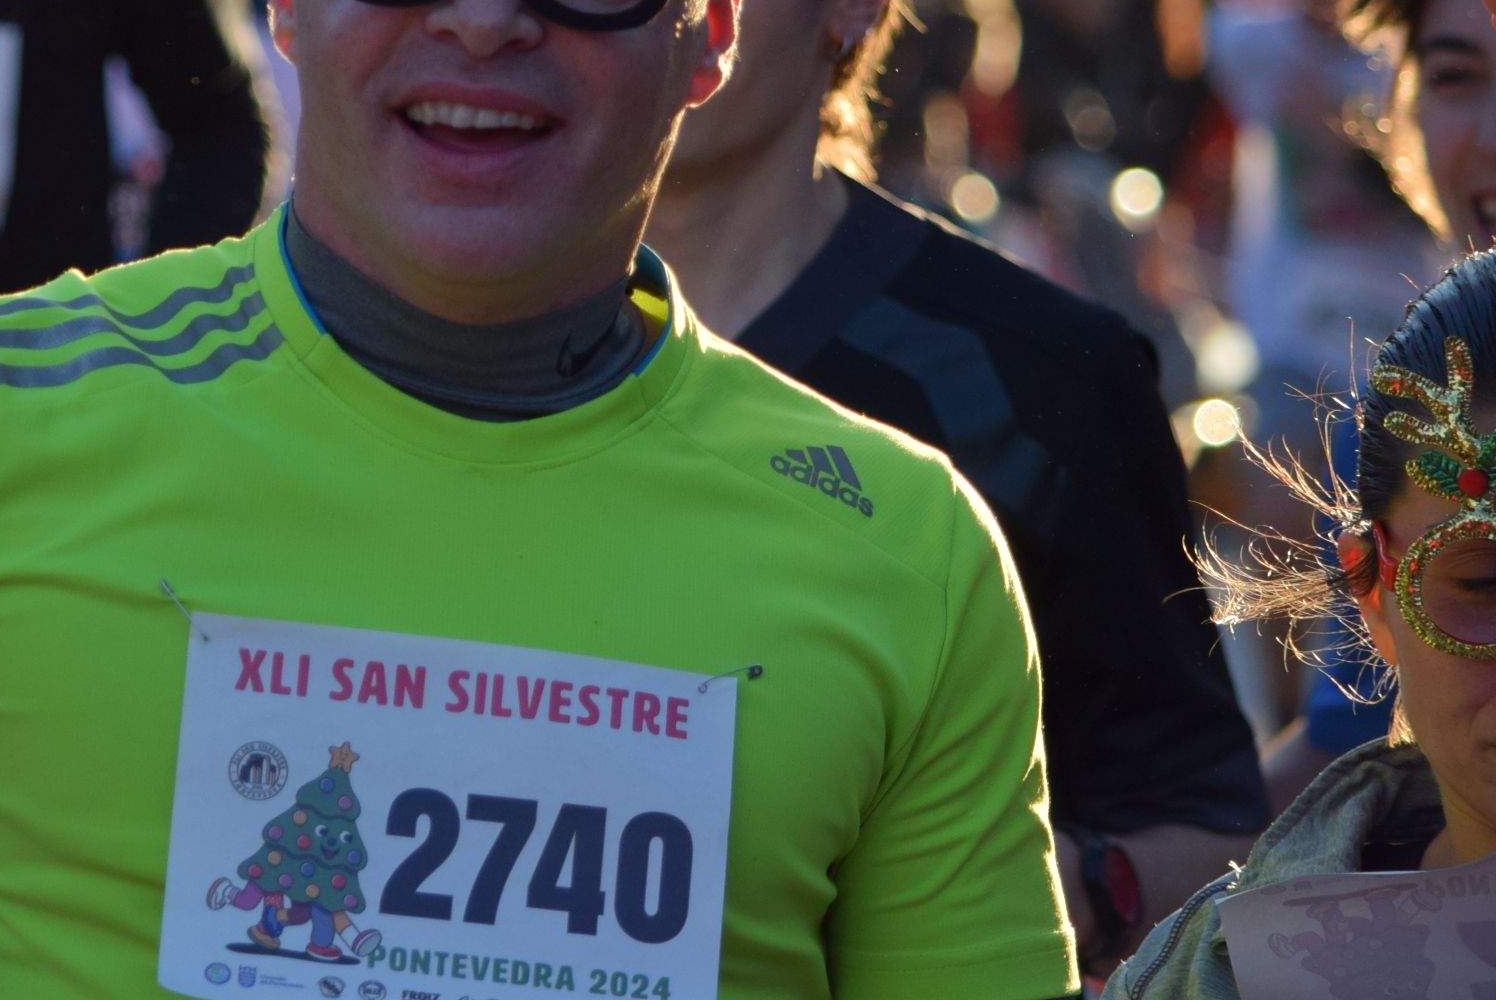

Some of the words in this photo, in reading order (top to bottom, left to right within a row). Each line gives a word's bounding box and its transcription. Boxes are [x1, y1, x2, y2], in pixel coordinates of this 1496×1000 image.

[769, 455, 874, 518] adidas
[234, 647, 310, 698] XLI
[328, 657, 427, 709] SAN
[444, 669, 690, 740] SILVESTRE
[378, 786, 694, 946] 2740
[366, 945, 575, 992] PONTEVEDRA
[589, 968, 672, 1000] 2024
